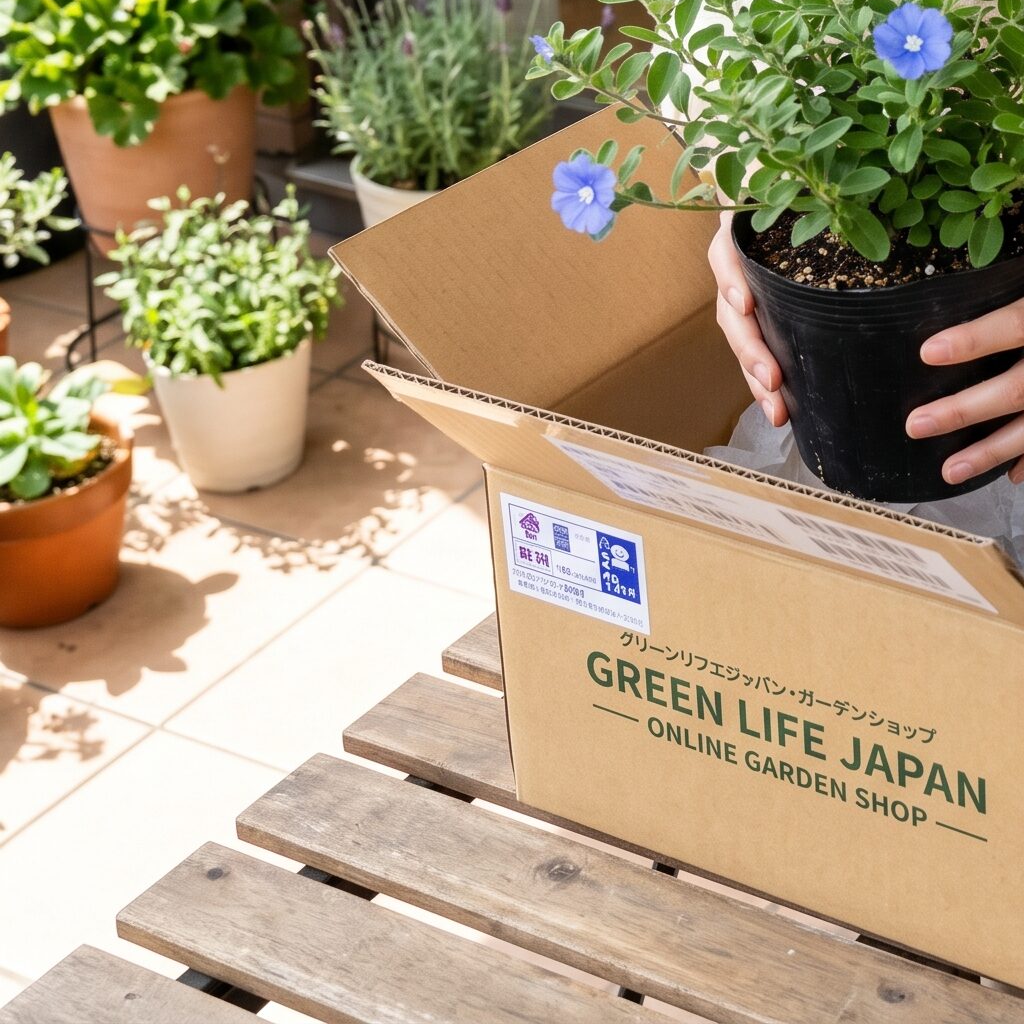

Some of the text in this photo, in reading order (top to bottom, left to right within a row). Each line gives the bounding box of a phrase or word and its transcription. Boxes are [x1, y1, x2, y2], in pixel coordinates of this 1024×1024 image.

[586, 651, 988, 815] GREEN LIFE JAPAN
[647, 716, 928, 827] ONLINE GARDEN SHOP
